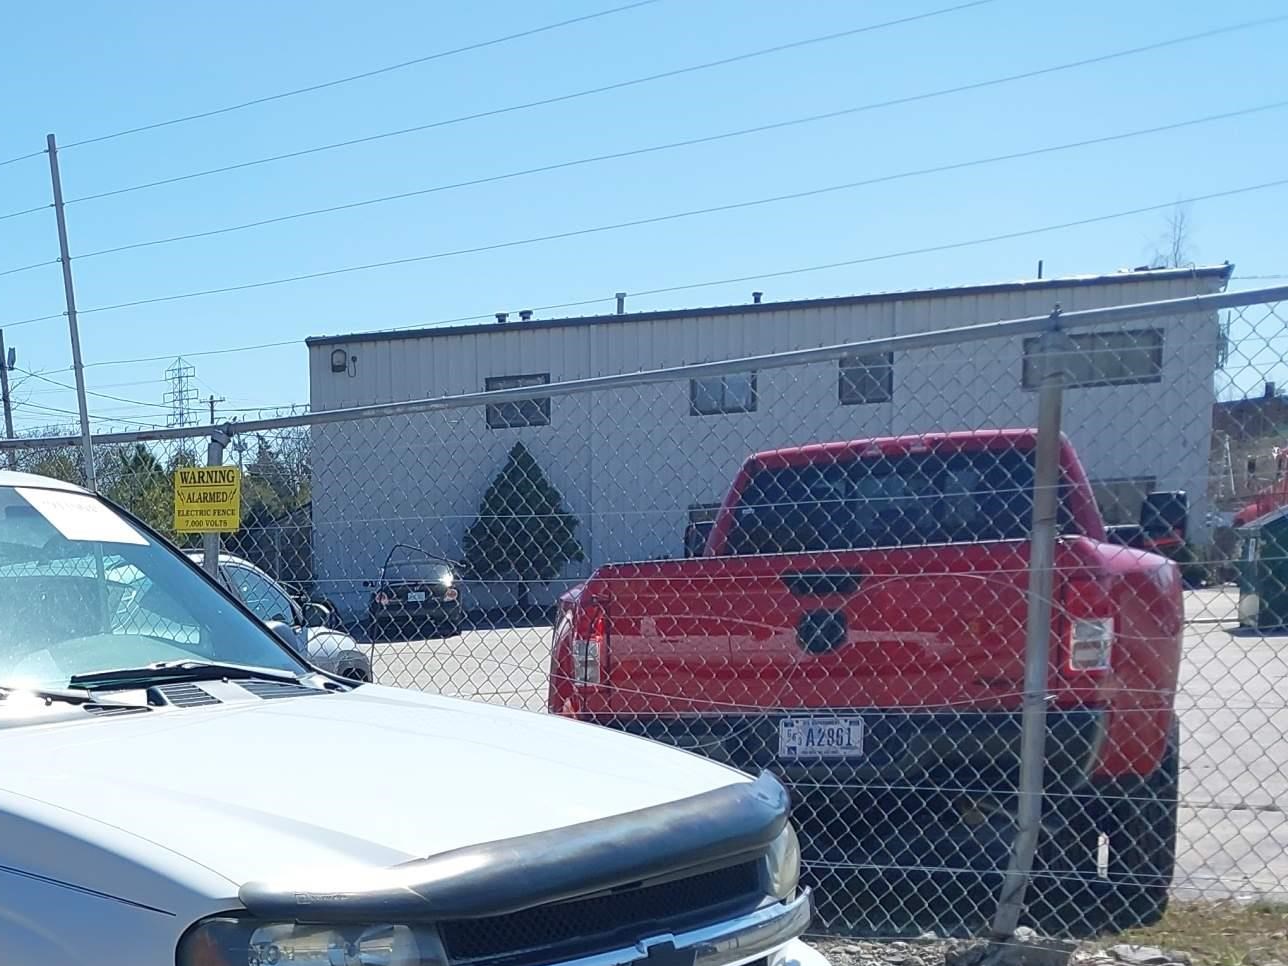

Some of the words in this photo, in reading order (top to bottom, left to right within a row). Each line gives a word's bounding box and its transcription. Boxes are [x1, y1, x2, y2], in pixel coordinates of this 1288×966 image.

[180, 469, 235, 484] WARNING
[186, 491, 228, 503] ALARMED
[177, 509, 210, 517] ELECTRIC
[212, 508, 235, 517] FENCE
[205, 519, 228, 527] VOLTS
